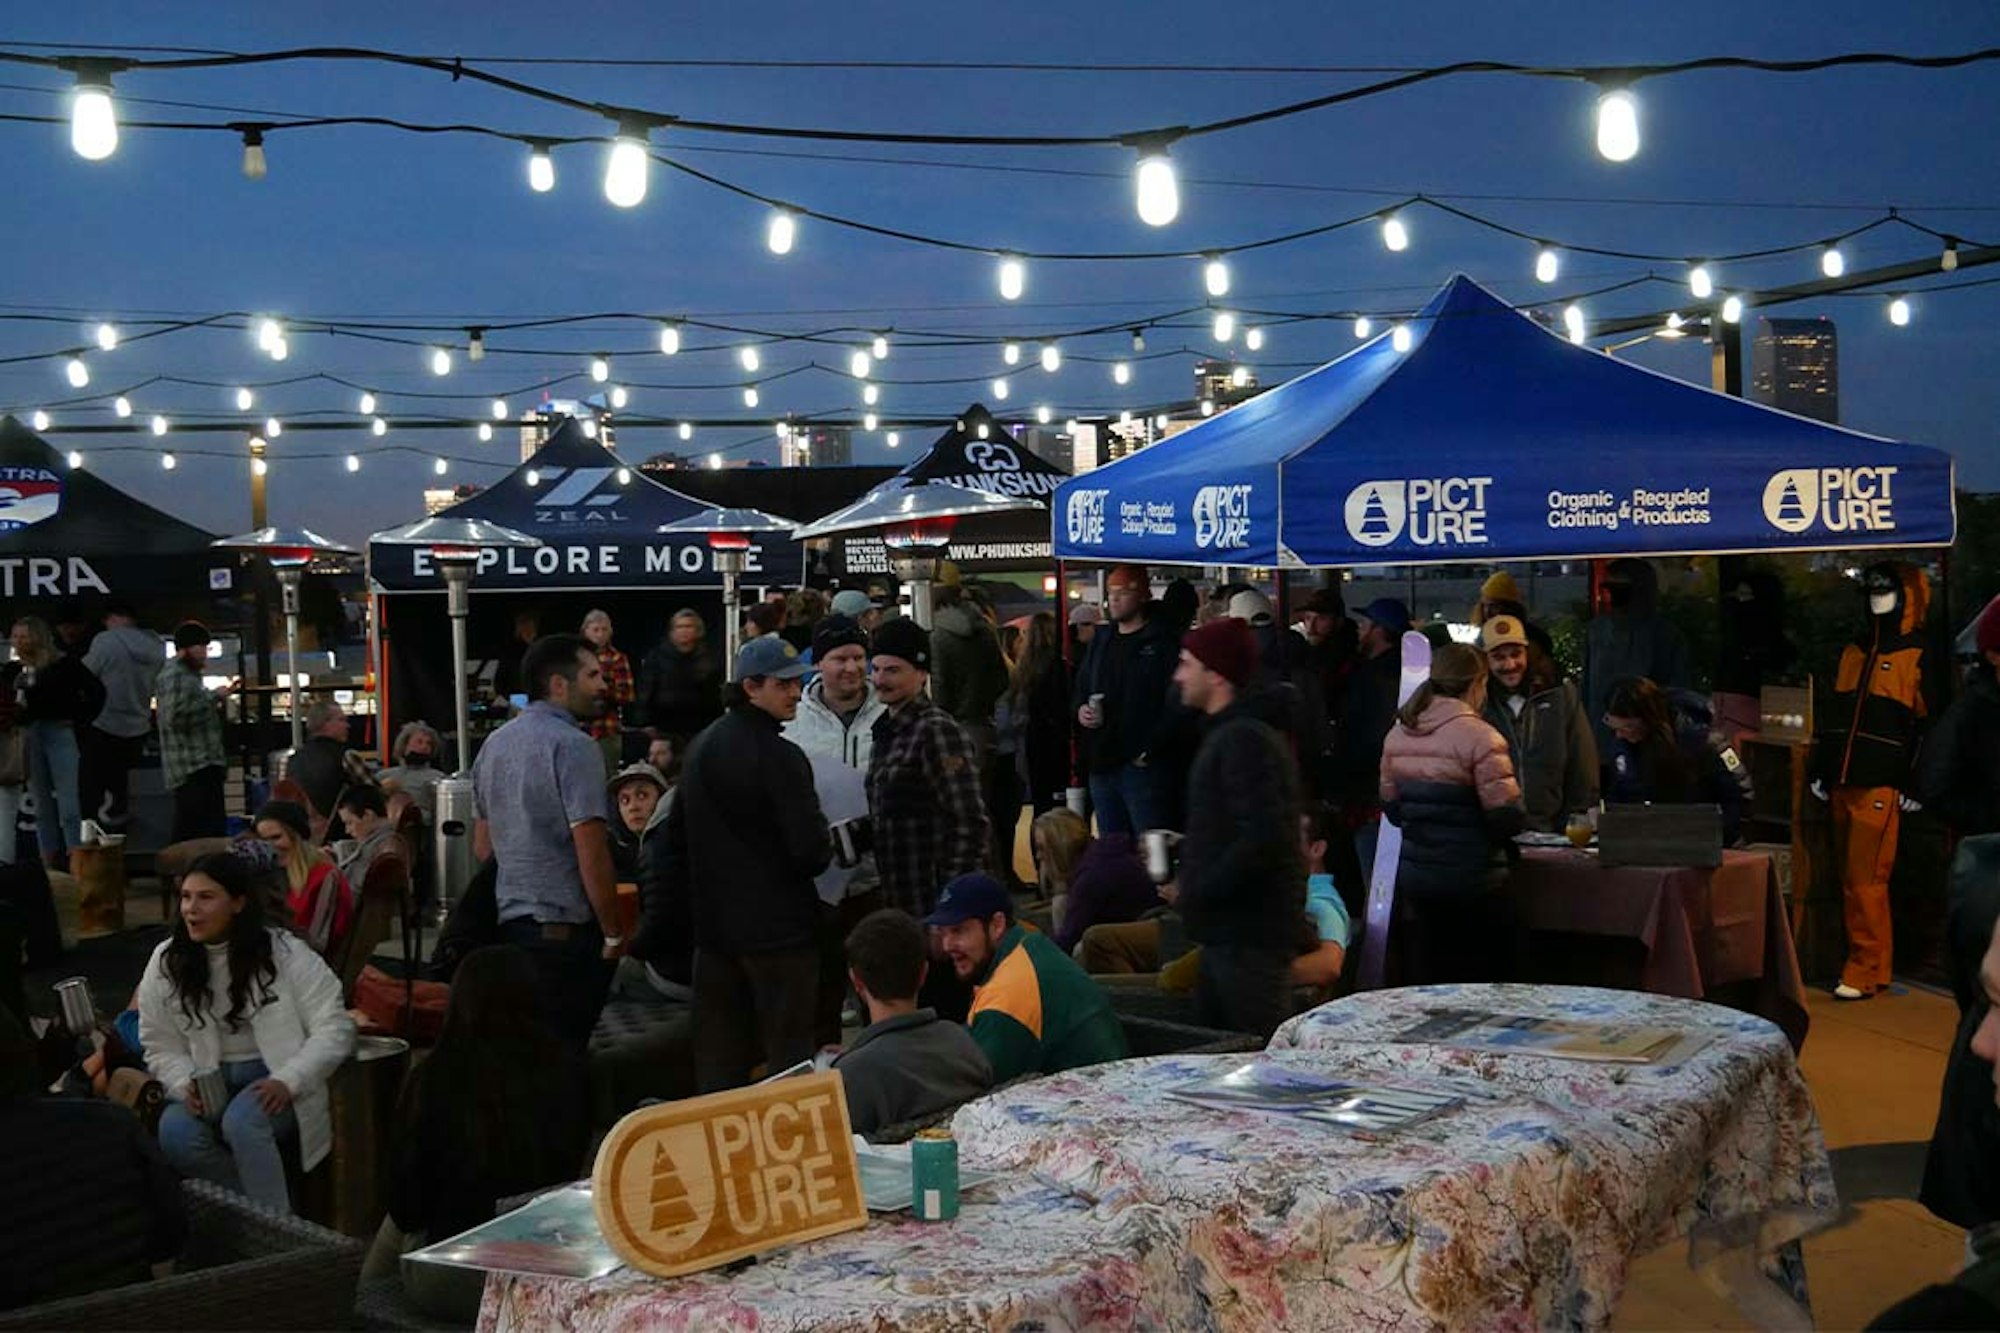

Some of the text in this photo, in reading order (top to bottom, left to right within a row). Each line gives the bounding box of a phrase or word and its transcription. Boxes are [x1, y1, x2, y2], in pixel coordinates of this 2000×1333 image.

[0, 467, 60, 482] TRA
[1821, 466, 1898, 500] PICT
[1083, 489, 1110, 517] PICT
[1216, 485, 1253, 518] PICT
[1409, 476, 1493, 512] PICT
[1547, 488, 1710, 519] Organic & Recycled
[535, 510, 630, 523] ZEAL
[1409, 510, 1489, 546] URE
[1547, 508, 1711, 530] Clothing Products
[1821, 498, 1896, 533] URE
[1215, 517, 1252, 549] URE
[412, 545, 764, 577] EPLORE MOE
[846, 554, 888, 564] PLASTIC
[945, 542, 1051, 561] WW.PHUNKSHU
[712, 1094, 832, 1175] PICT
[721, 1155, 843, 1236] URE
